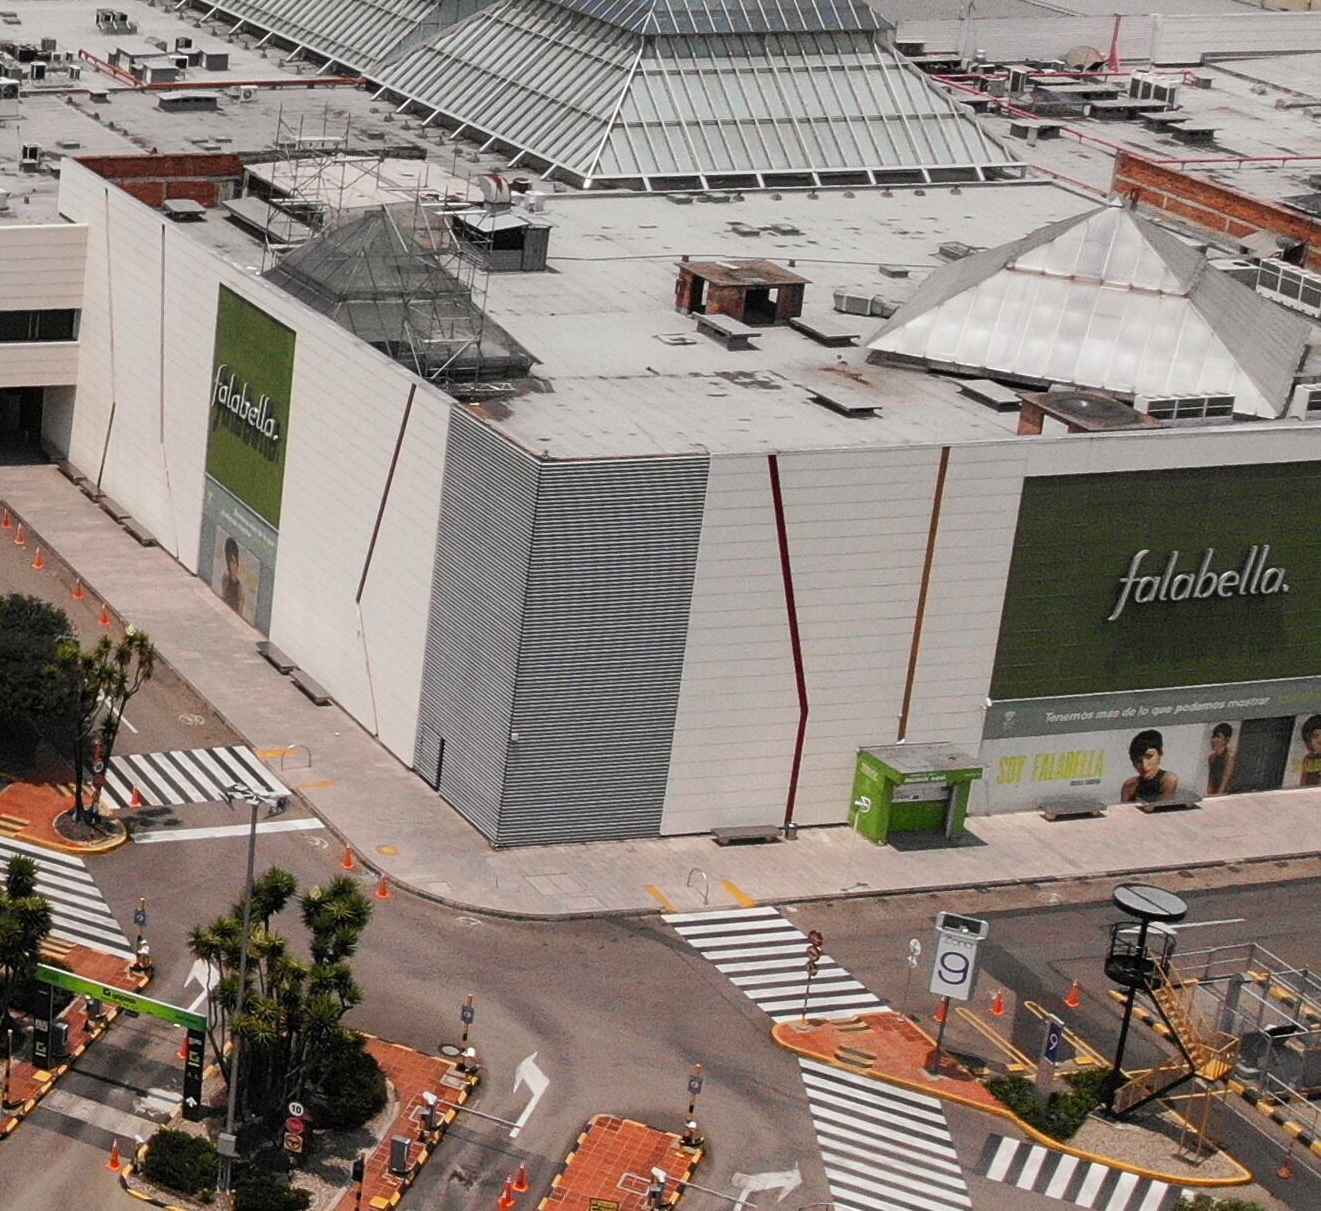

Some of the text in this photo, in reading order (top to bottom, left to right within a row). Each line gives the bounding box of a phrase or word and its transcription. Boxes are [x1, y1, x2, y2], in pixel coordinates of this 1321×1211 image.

[1045, 711, 1094, 723] Tenemos
[1121, 707, 1136, 718] de
[1137, 705, 1150, 717] lo
[1151, 705, 1173, 717] que
[1173, 700, 1227, 715] podemos
[1227, 697, 1272, 708] mostrar
[938, 951, 970, 985] 9
[1049, 1033, 1059, 1050] 9
